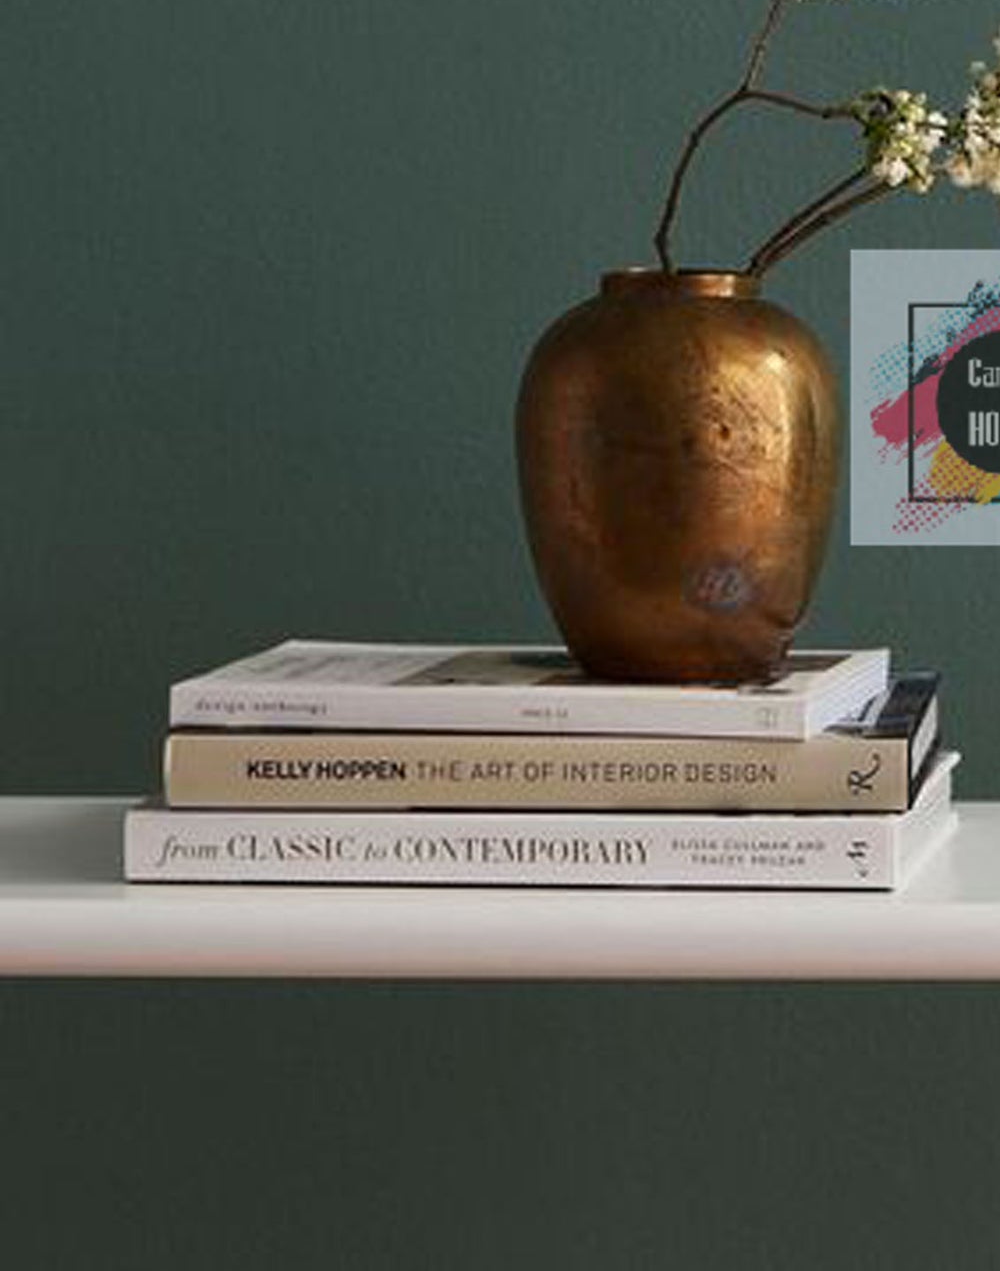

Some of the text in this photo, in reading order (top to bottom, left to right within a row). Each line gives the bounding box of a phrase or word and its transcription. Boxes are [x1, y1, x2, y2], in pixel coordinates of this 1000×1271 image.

[247, 760, 777, 784] KELLY HOPPEN THE ART OF INTERIOR DESIGN
[156, 835, 653, 867] from CLASSIC to CONTEMPORARY
